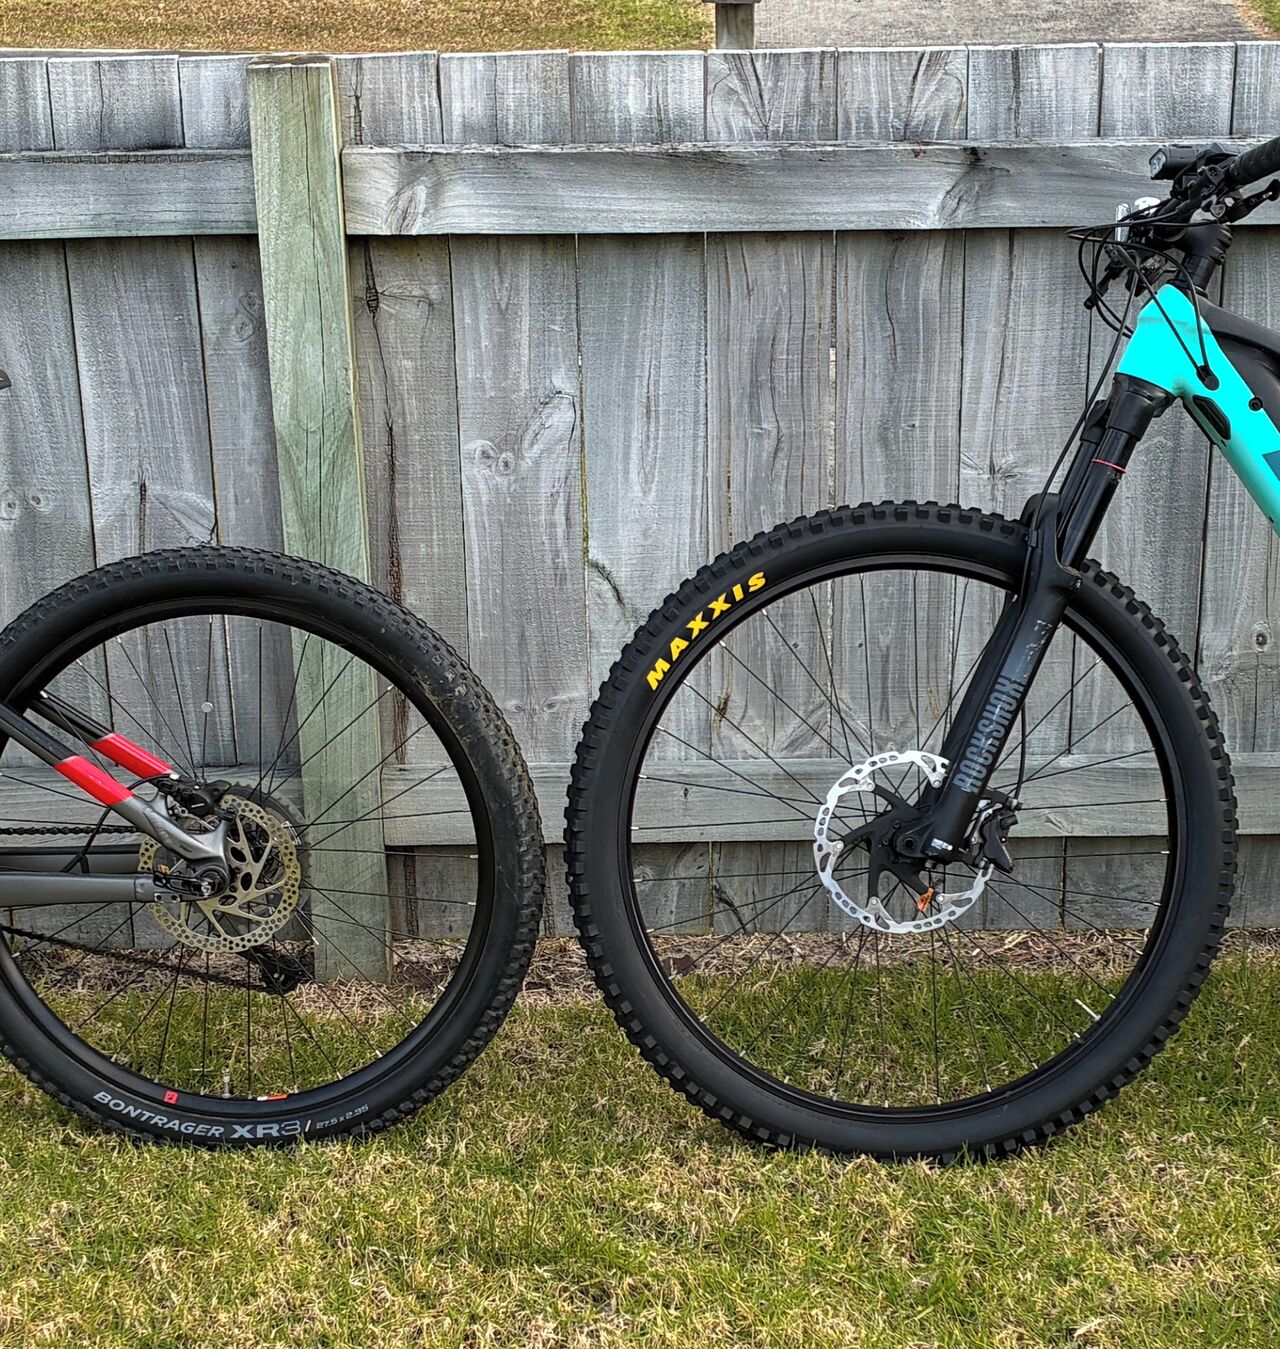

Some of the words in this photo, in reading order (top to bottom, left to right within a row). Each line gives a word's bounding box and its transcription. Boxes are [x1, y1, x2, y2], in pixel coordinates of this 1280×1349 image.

[646, 571, 766, 691] MAXXIS
[953, 674, 1026, 794] ROCKSHOX
[92, 1090, 225, 1139] BONTRAGER
[316, 1117, 338, 1129] 27.5
